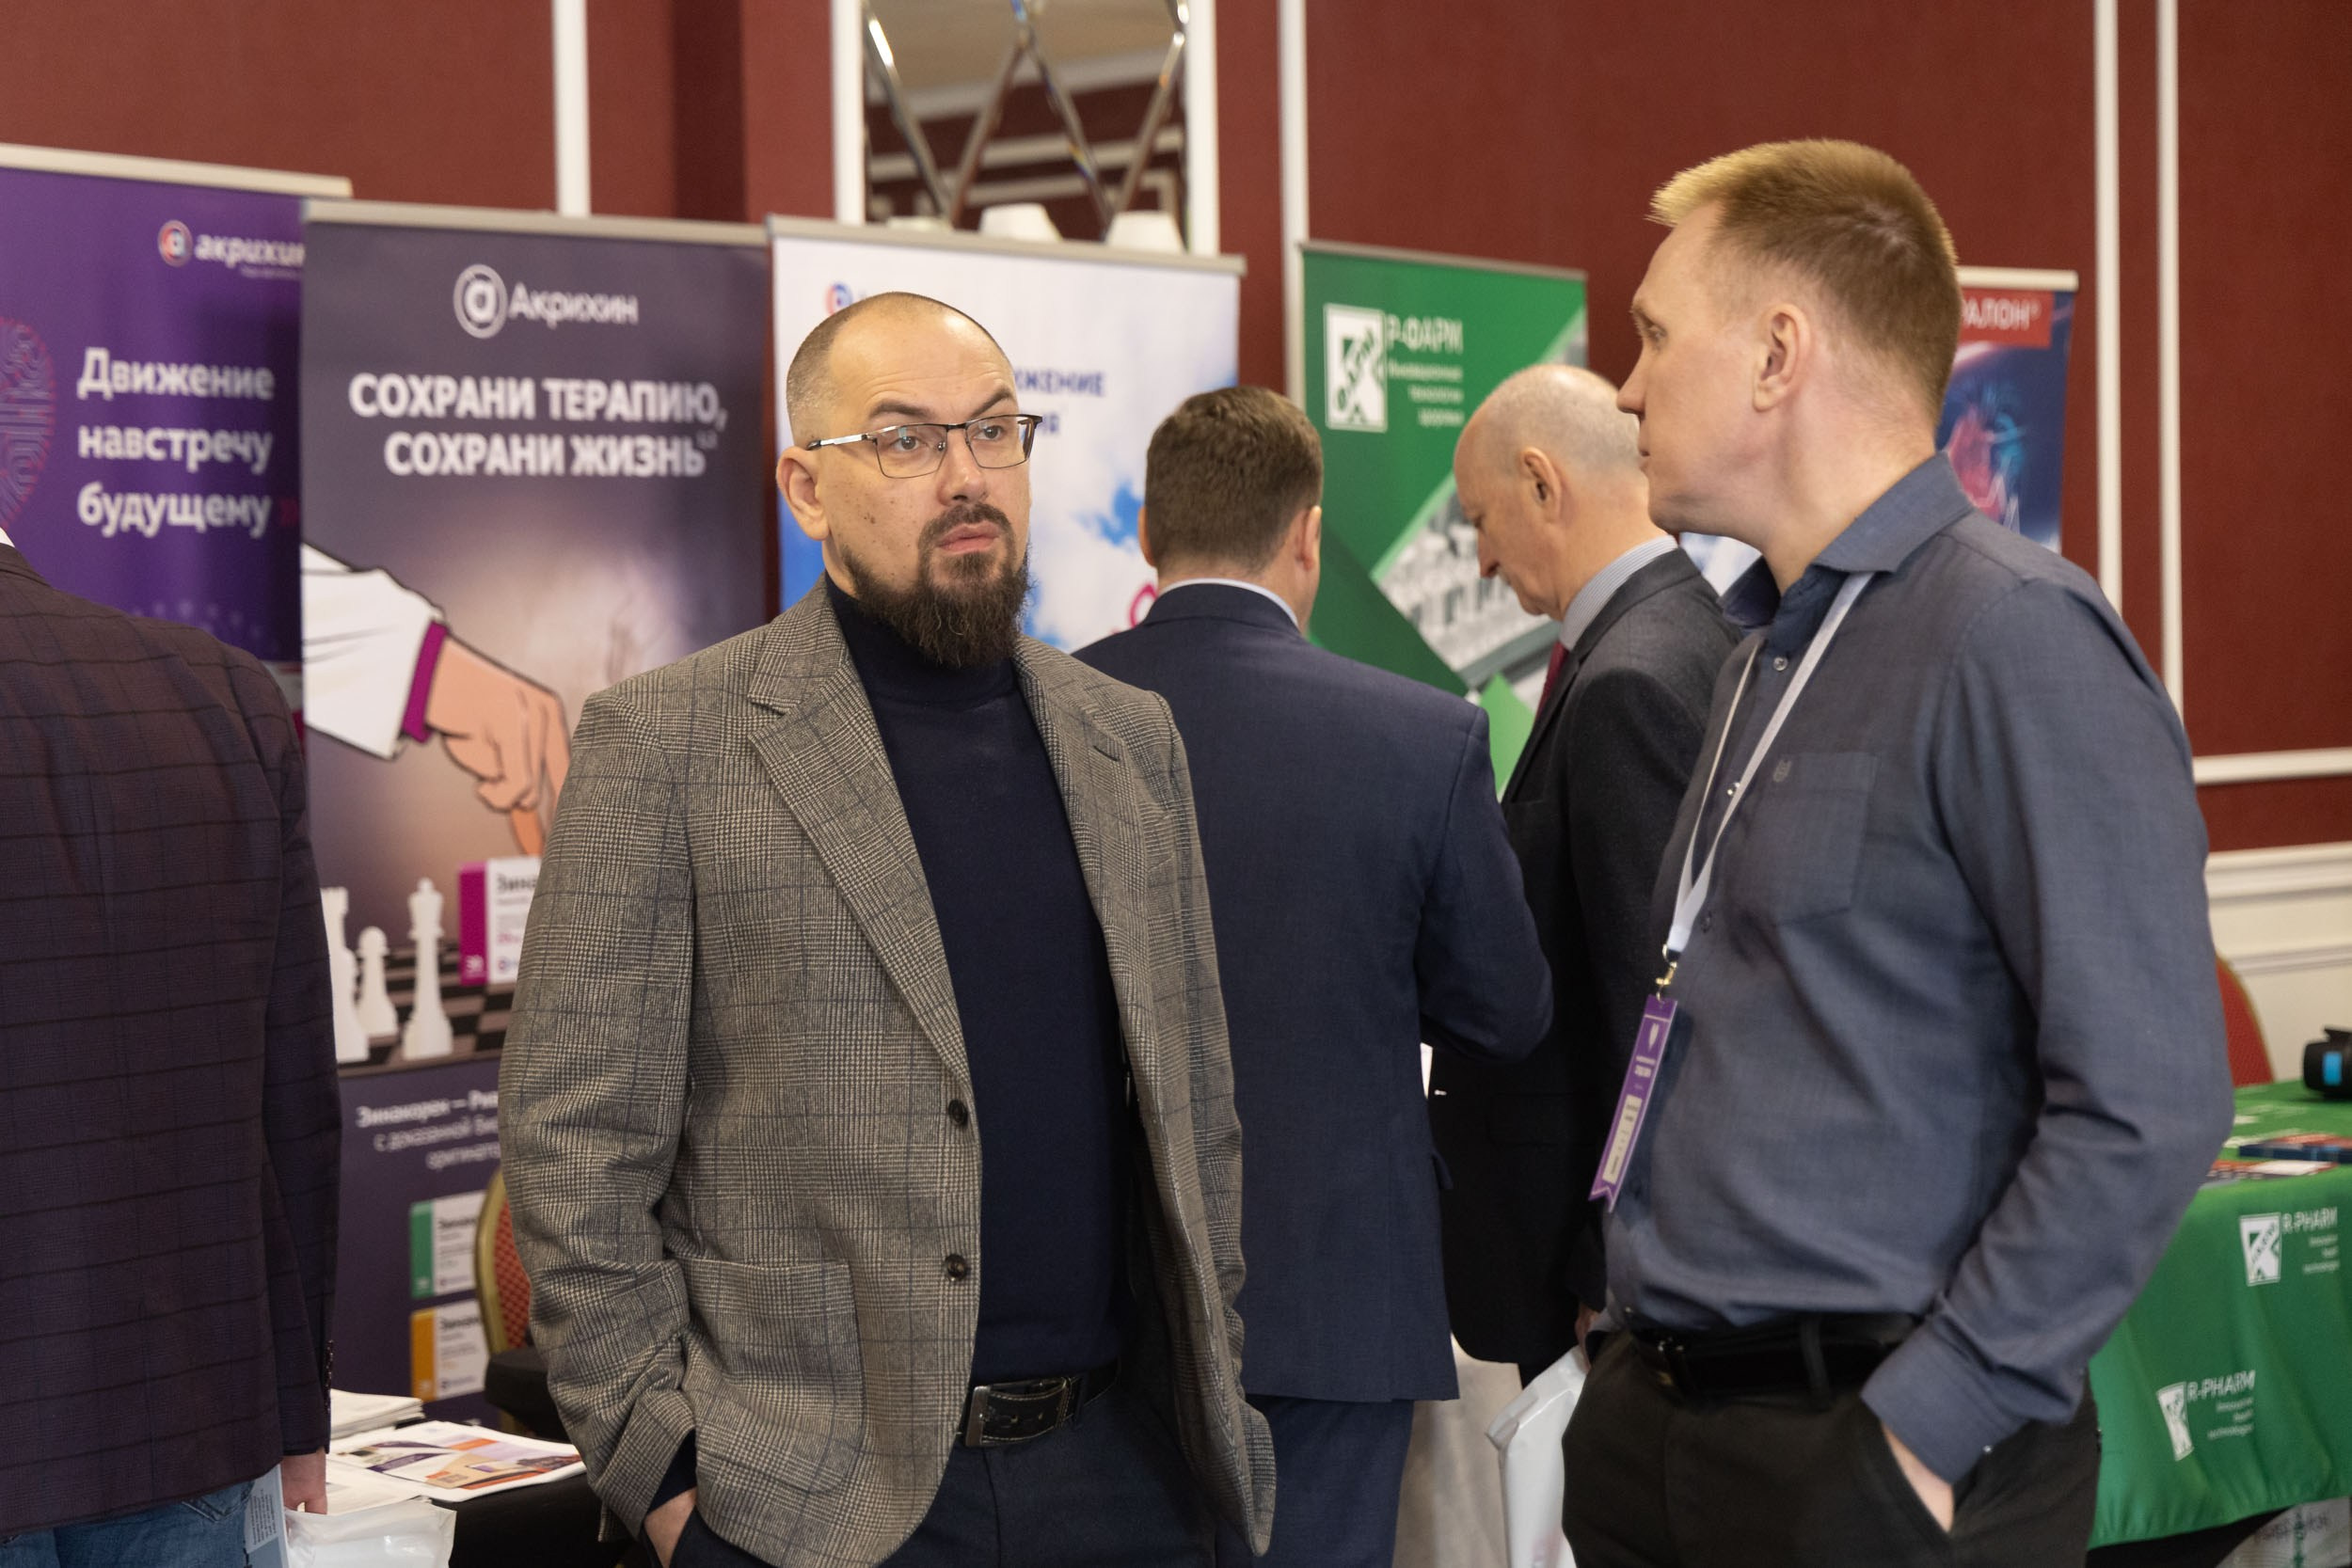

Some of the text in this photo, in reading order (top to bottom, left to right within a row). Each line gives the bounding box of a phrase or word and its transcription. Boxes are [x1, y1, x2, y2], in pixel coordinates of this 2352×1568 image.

[509, 281, 640, 330] Акрихин
[77, 346, 275, 401] Движение
[1014, 368, 1105, 397] ЖЕНИЕ
[348, 372, 728, 432] СОХРАНИ ТЕРАПИЮ,
[78, 425, 273, 474] навстречу
[384, 431, 565, 477] СОХРАНИ
[77, 481, 272, 539] будущему
[2186, 1369, 2256, 1402] R-PHARM
